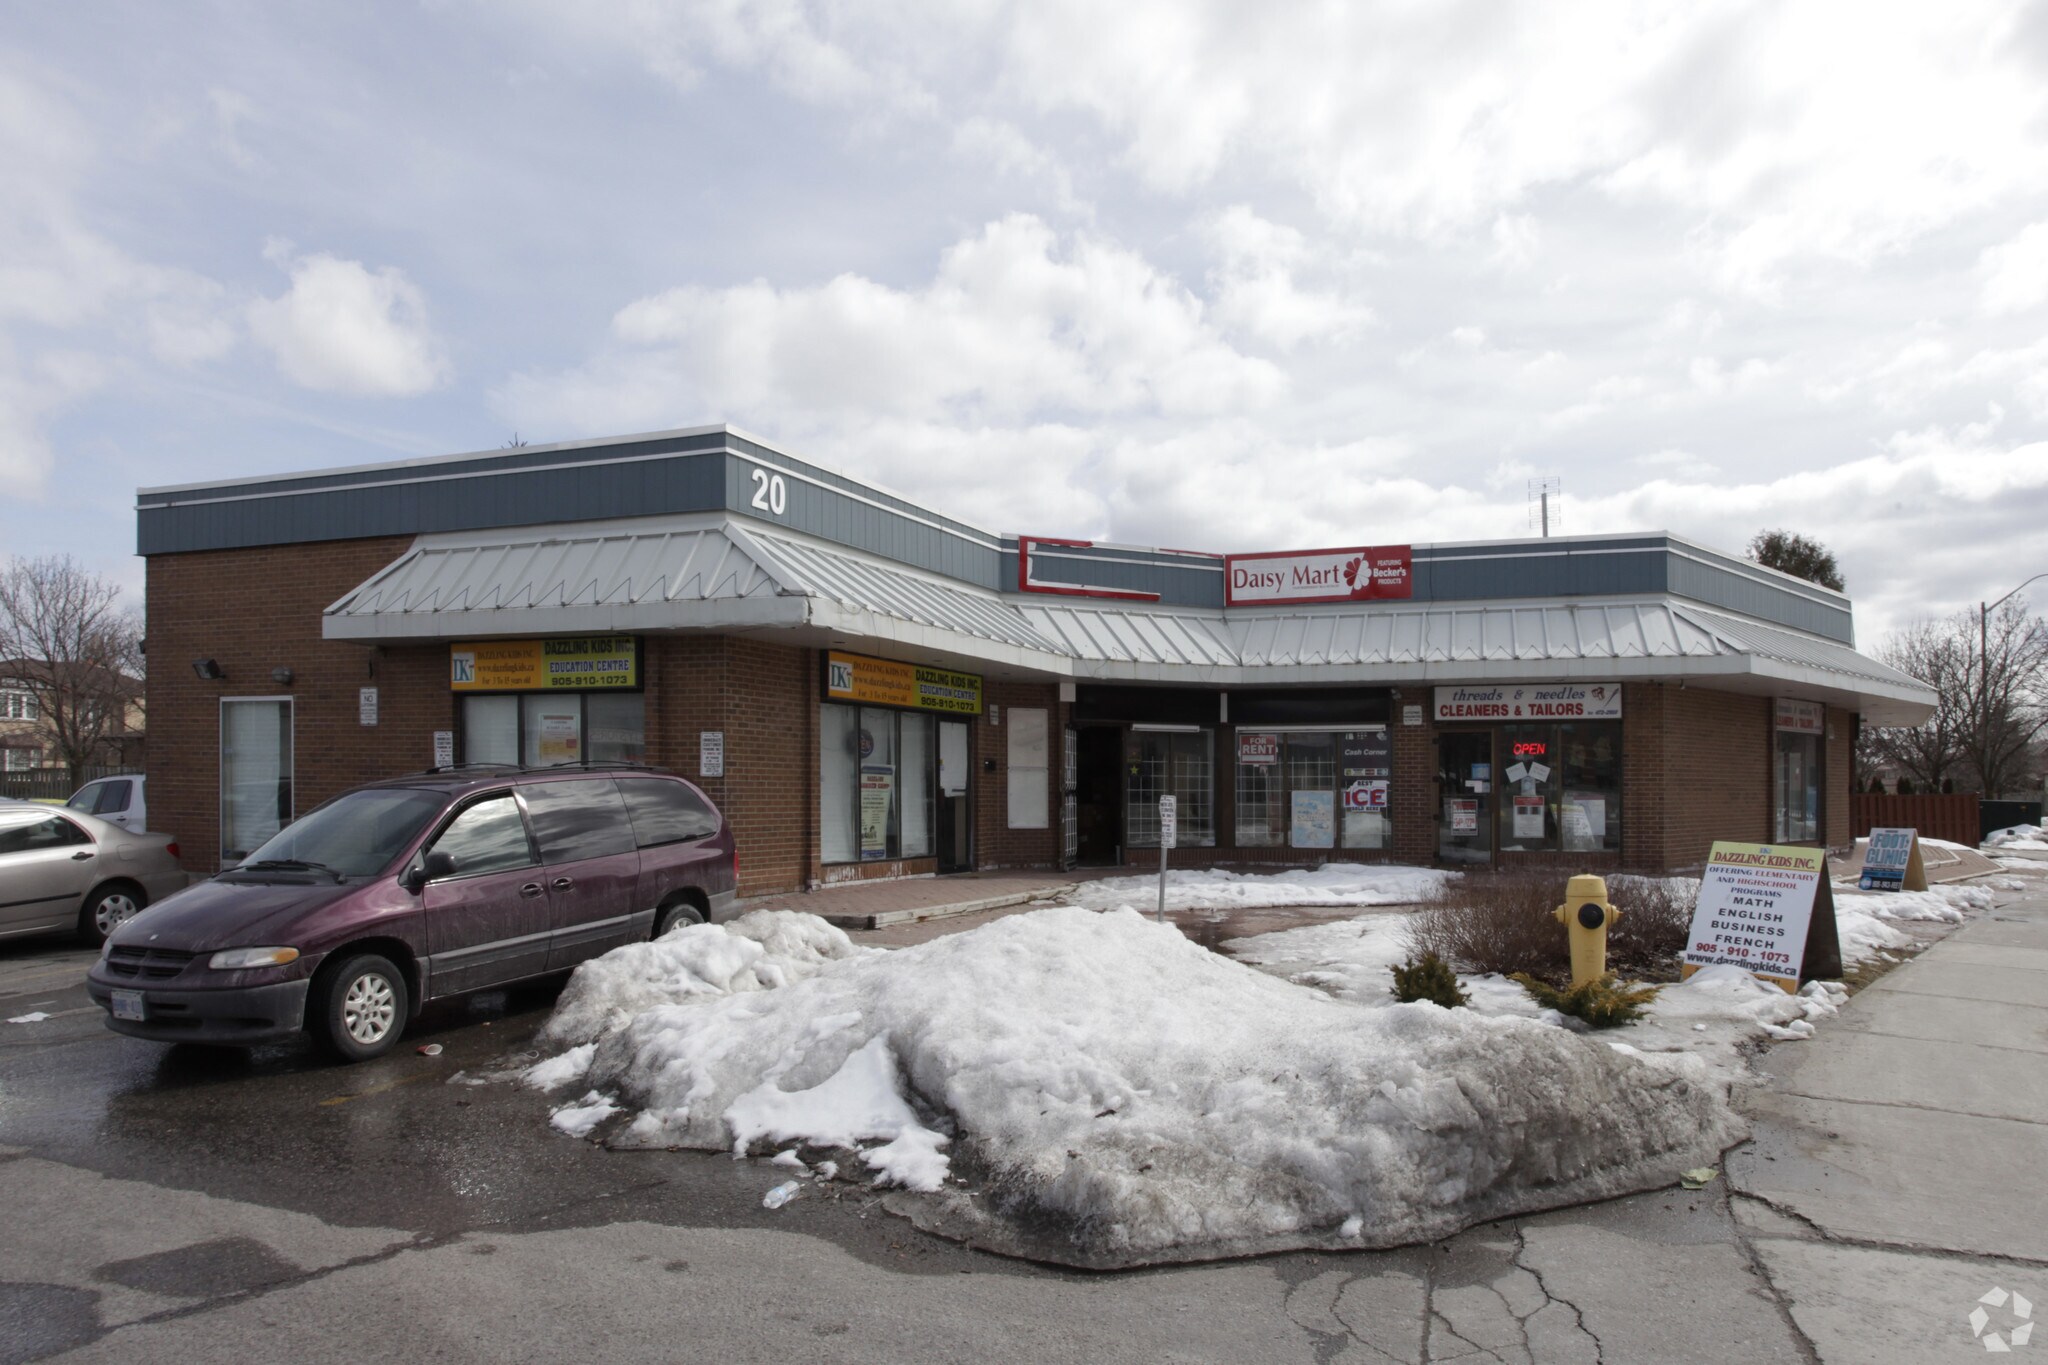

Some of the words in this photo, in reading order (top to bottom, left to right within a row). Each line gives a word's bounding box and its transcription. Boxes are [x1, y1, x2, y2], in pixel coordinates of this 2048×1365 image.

[751, 468, 786, 516] 20
[1233, 568, 1285, 593] Daisy
[1292, 564, 1340, 586] Mart
[1373, 566, 1407, 578] Becker's
[544, 640, 588, 655] DAZZLING
[591, 638, 612, 653] KIDS
[549, 660, 594, 673] EDUCATION
[596, 659, 629, 672] CENTRE
[552, 675, 628, 686] 905-910-1073
[916, 669, 949, 684] DAZZLING
[951, 675, 966, 688] KIDS
[967, 678, 979, 690] INC.
[920, 684, 952, 697] EDUCATION
[953, 689, 976, 700] CENTRE
[1453, 688, 1503, 701] threads
[1514, 688, 1524, 700] &
[1535, 687, 1585, 700] needles
[921, 697, 975, 711] 905-910-1073
[1440, 704, 1509, 716] CLEANERS
[1514, 705, 1522, 716] &
[1529, 703, 1584, 716] TAILORS
[1249, 737, 1267, 745] FOR
[1242, 745, 1274, 755] RENT
[1345, 748, 1362, 756] Cash
[1364, 748, 1387, 756] Corner
[1513, 743, 1546, 755] OPEN
[1345, 789, 1386, 807] ICE
[1874, 833, 1908, 849] FOOT
[1713, 851, 1765, 866] DAZZLING
[1767, 855, 1792, 868] KIDS
[1794, 857, 1815, 870] INC.
[1866, 848, 1908, 865] CLINIC
[1709, 866, 1752, 876] OFFERING
[1755, 870, 1816, 882] ELEMENTARY
[1716, 876, 1735, 884] AND
[1737, 878, 1798, 890] HIGHSCHOOL
[1730, 887, 1782, 898] PROGRAMS
[1733, 896, 1774, 908] MATH
[1718, 908, 1784, 923] ENGLISH
[1711, 920, 1785, 937] BUSINESS
[1715, 934, 1775, 949] FRENCH
[1696, 942, 1717, 953] 905
[1727, 946, 1749, 958] 910
[1760, 950, 1790, 964] 1073
[1687, 953, 1797, 976] www.dazzlingkids.ca
